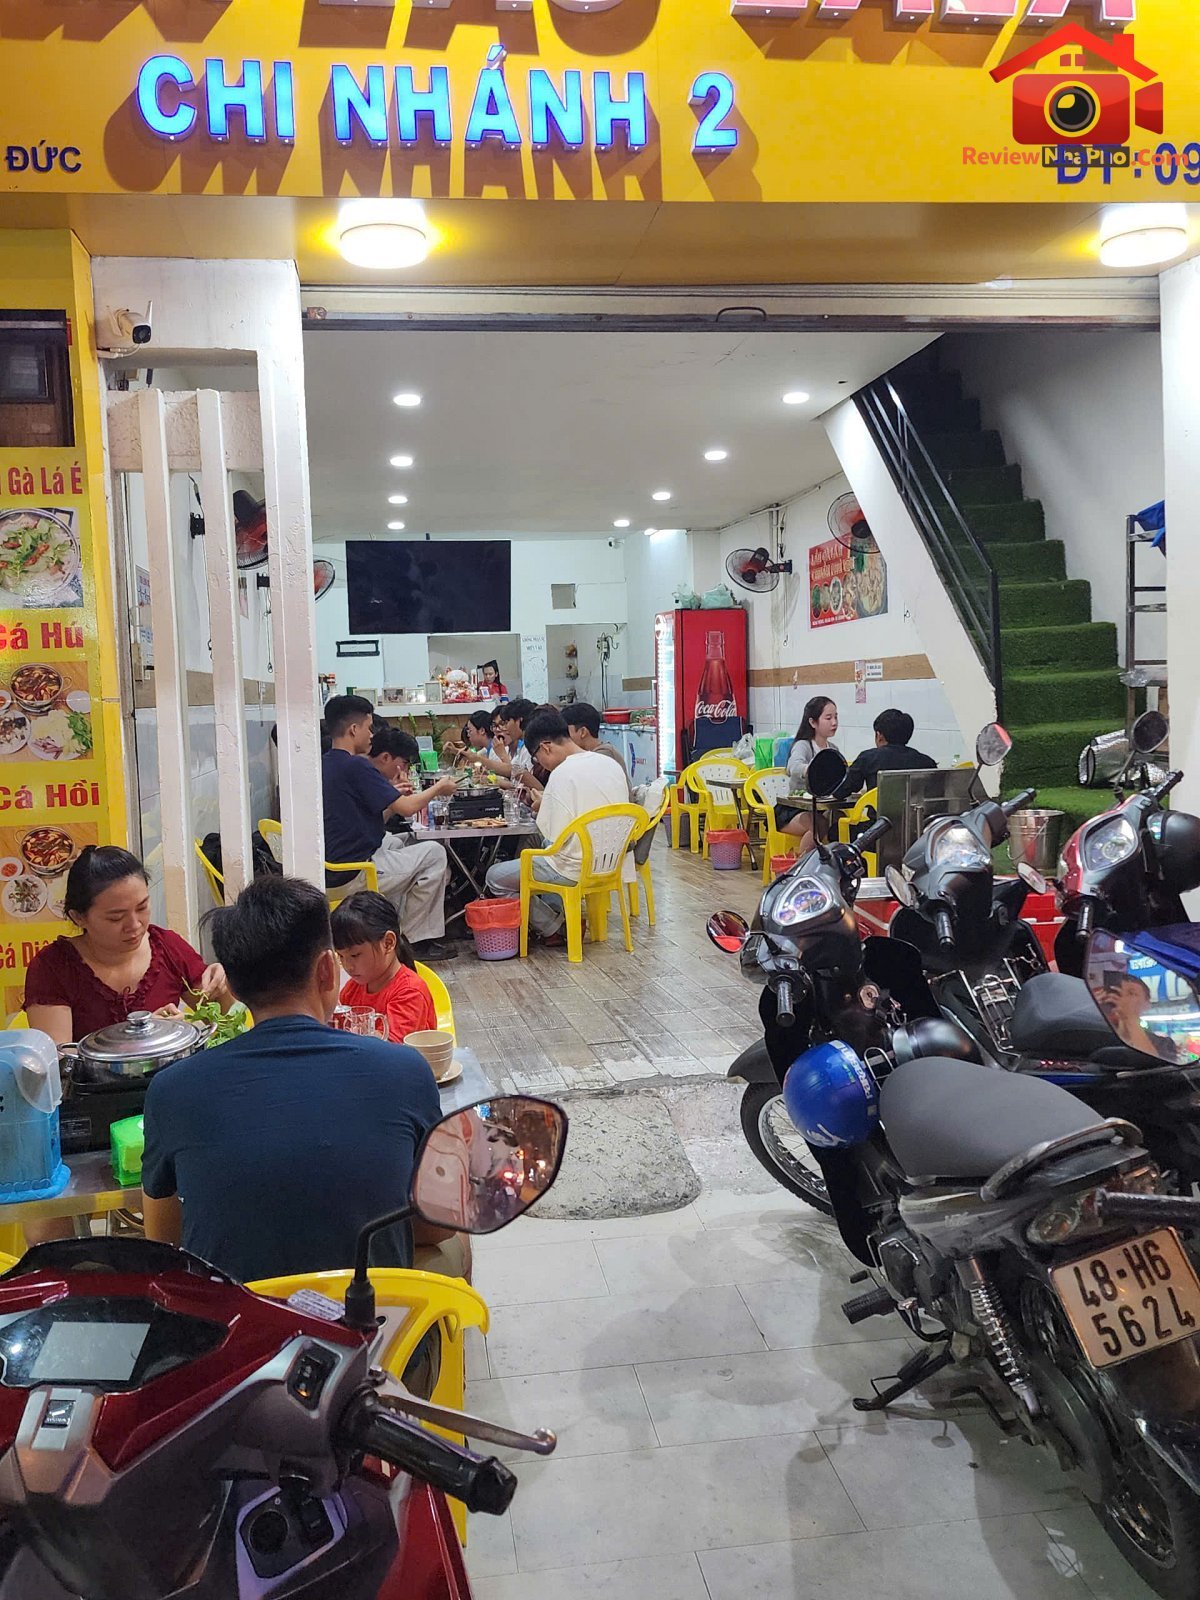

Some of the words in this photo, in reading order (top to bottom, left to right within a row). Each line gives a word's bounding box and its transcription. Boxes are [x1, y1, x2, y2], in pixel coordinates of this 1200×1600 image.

[136, 54, 295, 144] CHI
[331, 44, 648, 151] NHÁNH
[689, 71, 738, 153] 2
[5, 139, 82, 173] ĐỨC
[8, 466, 34, 495] Gà
[41, 466, 64, 495] Lá
[70, 461, 83, 494] É
[41, 621, 84, 649] Hú
[0, 784, 33, 810] Cá
[45, 779, 100, 808] Hồi
[1072, 1239, 1172, 1308] 48-H6
[1091, 1286, 1196, 1357] 5624
